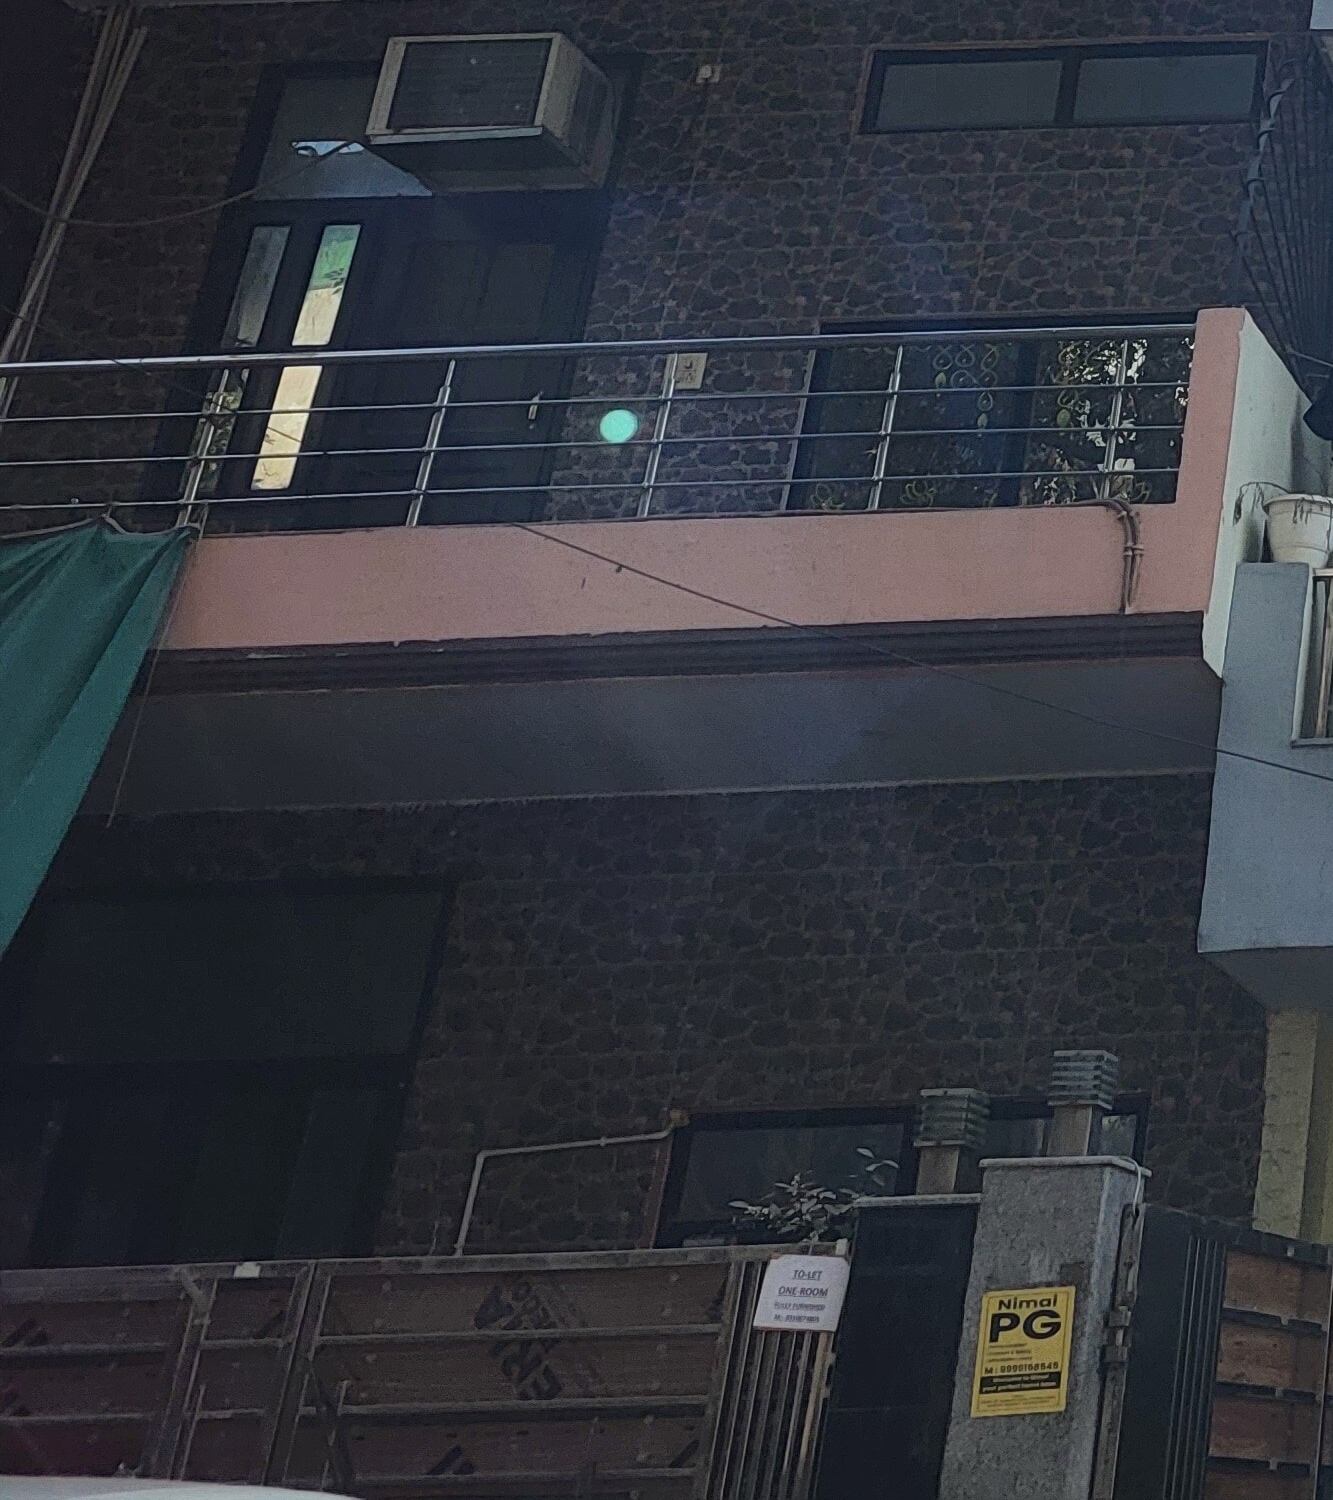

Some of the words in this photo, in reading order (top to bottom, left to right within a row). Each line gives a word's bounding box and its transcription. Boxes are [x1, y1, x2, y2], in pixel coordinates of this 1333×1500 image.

[792, 1269, 823, 1279] TO-LET
[998, 1294, 1058, 1311] Nimai
[988, 1309, 1062, 1343] PG
